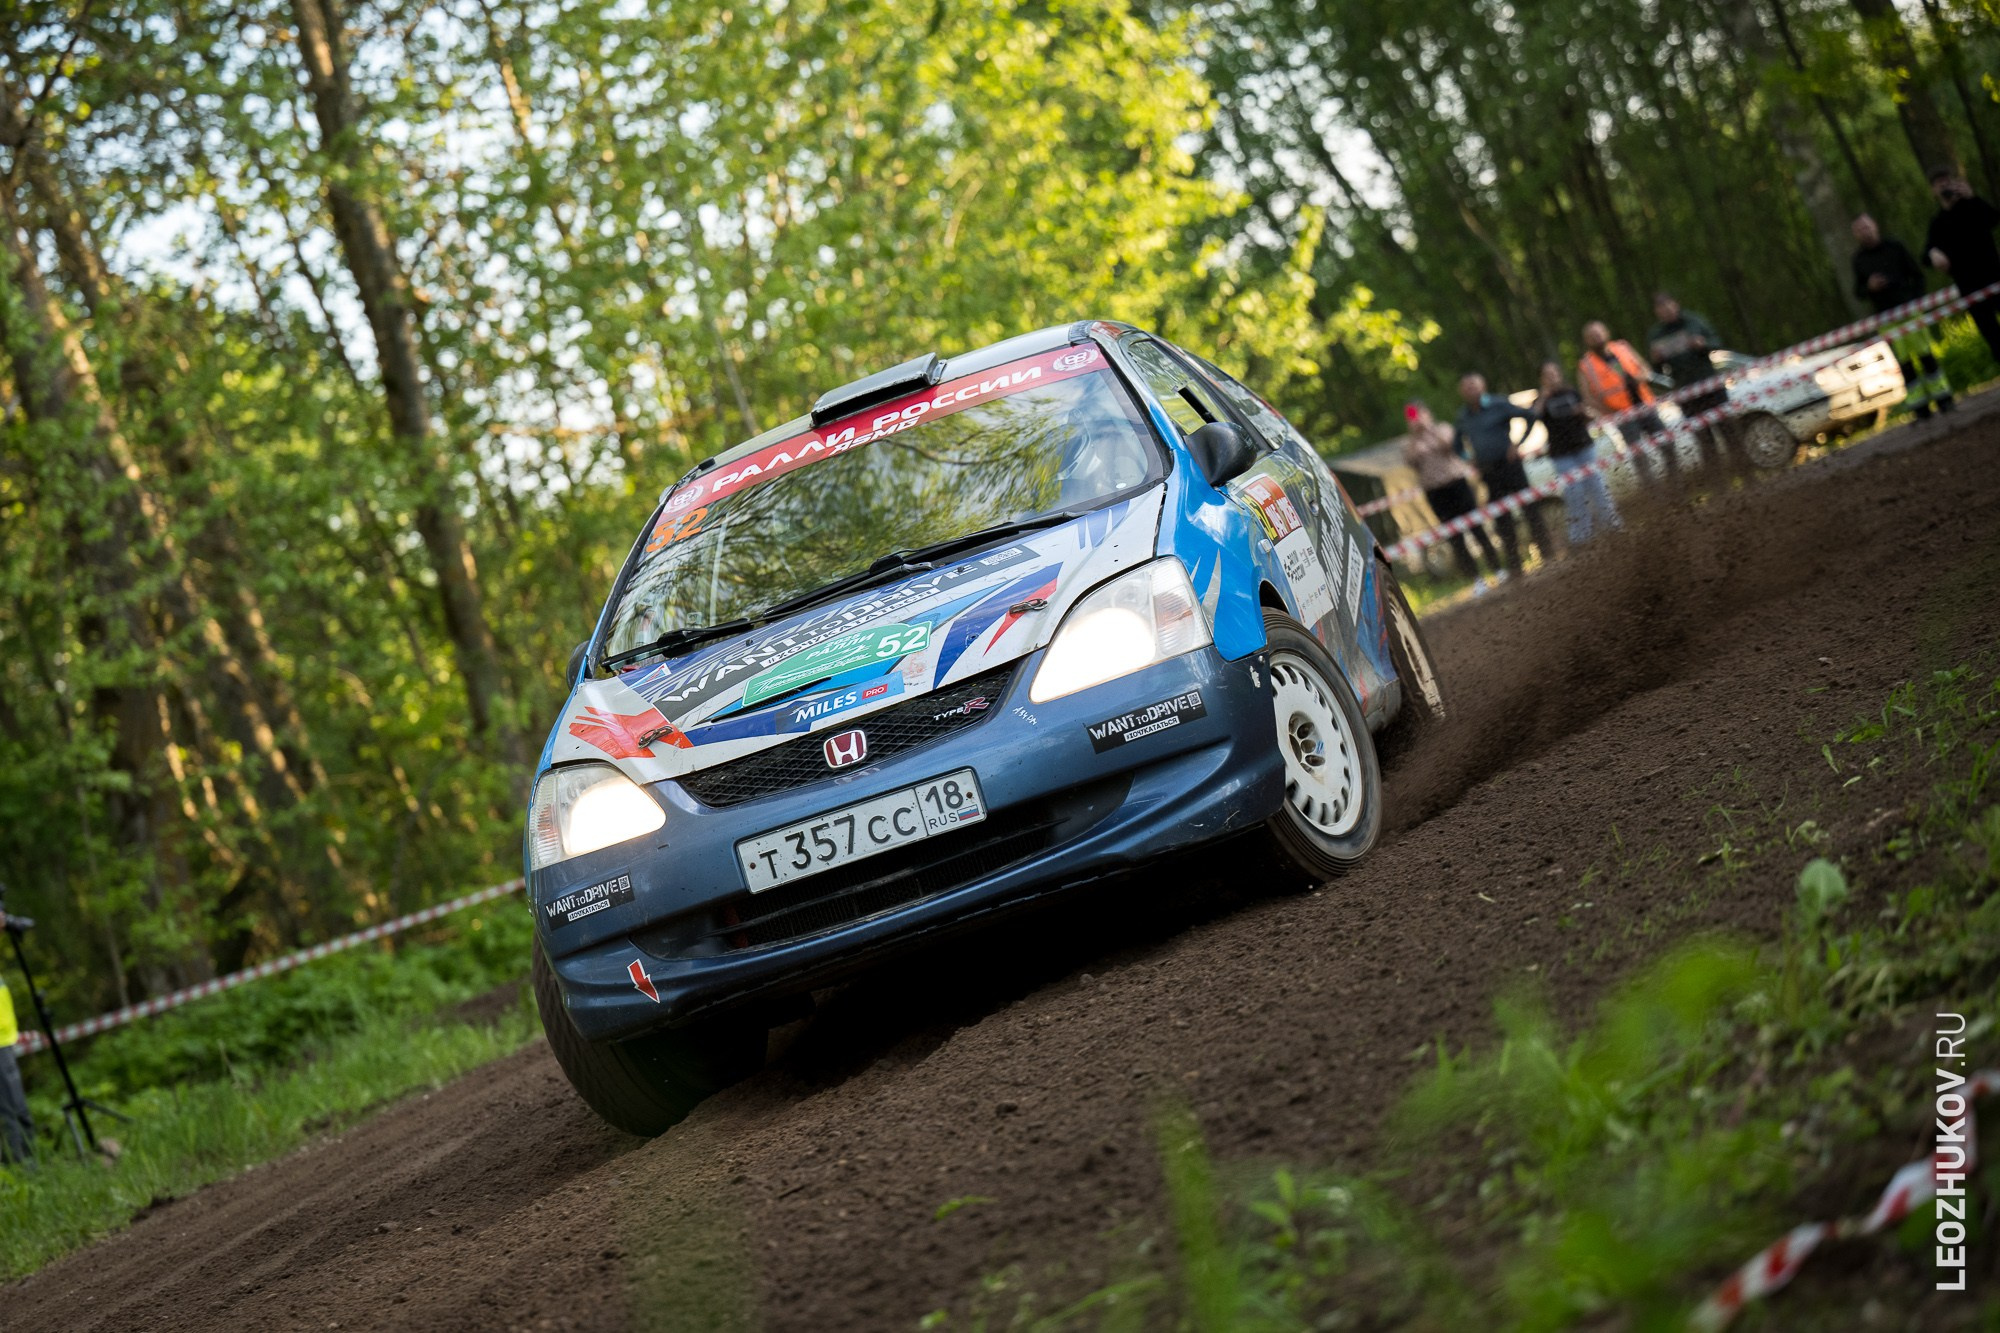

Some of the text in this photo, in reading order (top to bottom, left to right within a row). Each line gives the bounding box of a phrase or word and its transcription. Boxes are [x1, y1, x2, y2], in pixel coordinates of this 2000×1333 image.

[711, 366, 1042, 493] РАЛЛИ РОССИИ
[645, 507, 708, 553] 52
[805, 632, 875, 660] РАЛЛИ
[876, 626, 928, 658] 52
[662, 633, 800, 701] WANT
[795, 686, 885, 723] MILES PRO
[1089, 714, 1135, 740] WANT
[1146, 695, 1189, 720] DRIVE
[924, 780, 964, 815] 18
[928, 812, 958, 830] RUS
[546, 894, 577, 917] WANT
[584, 879, 619, 902] DRIVE
